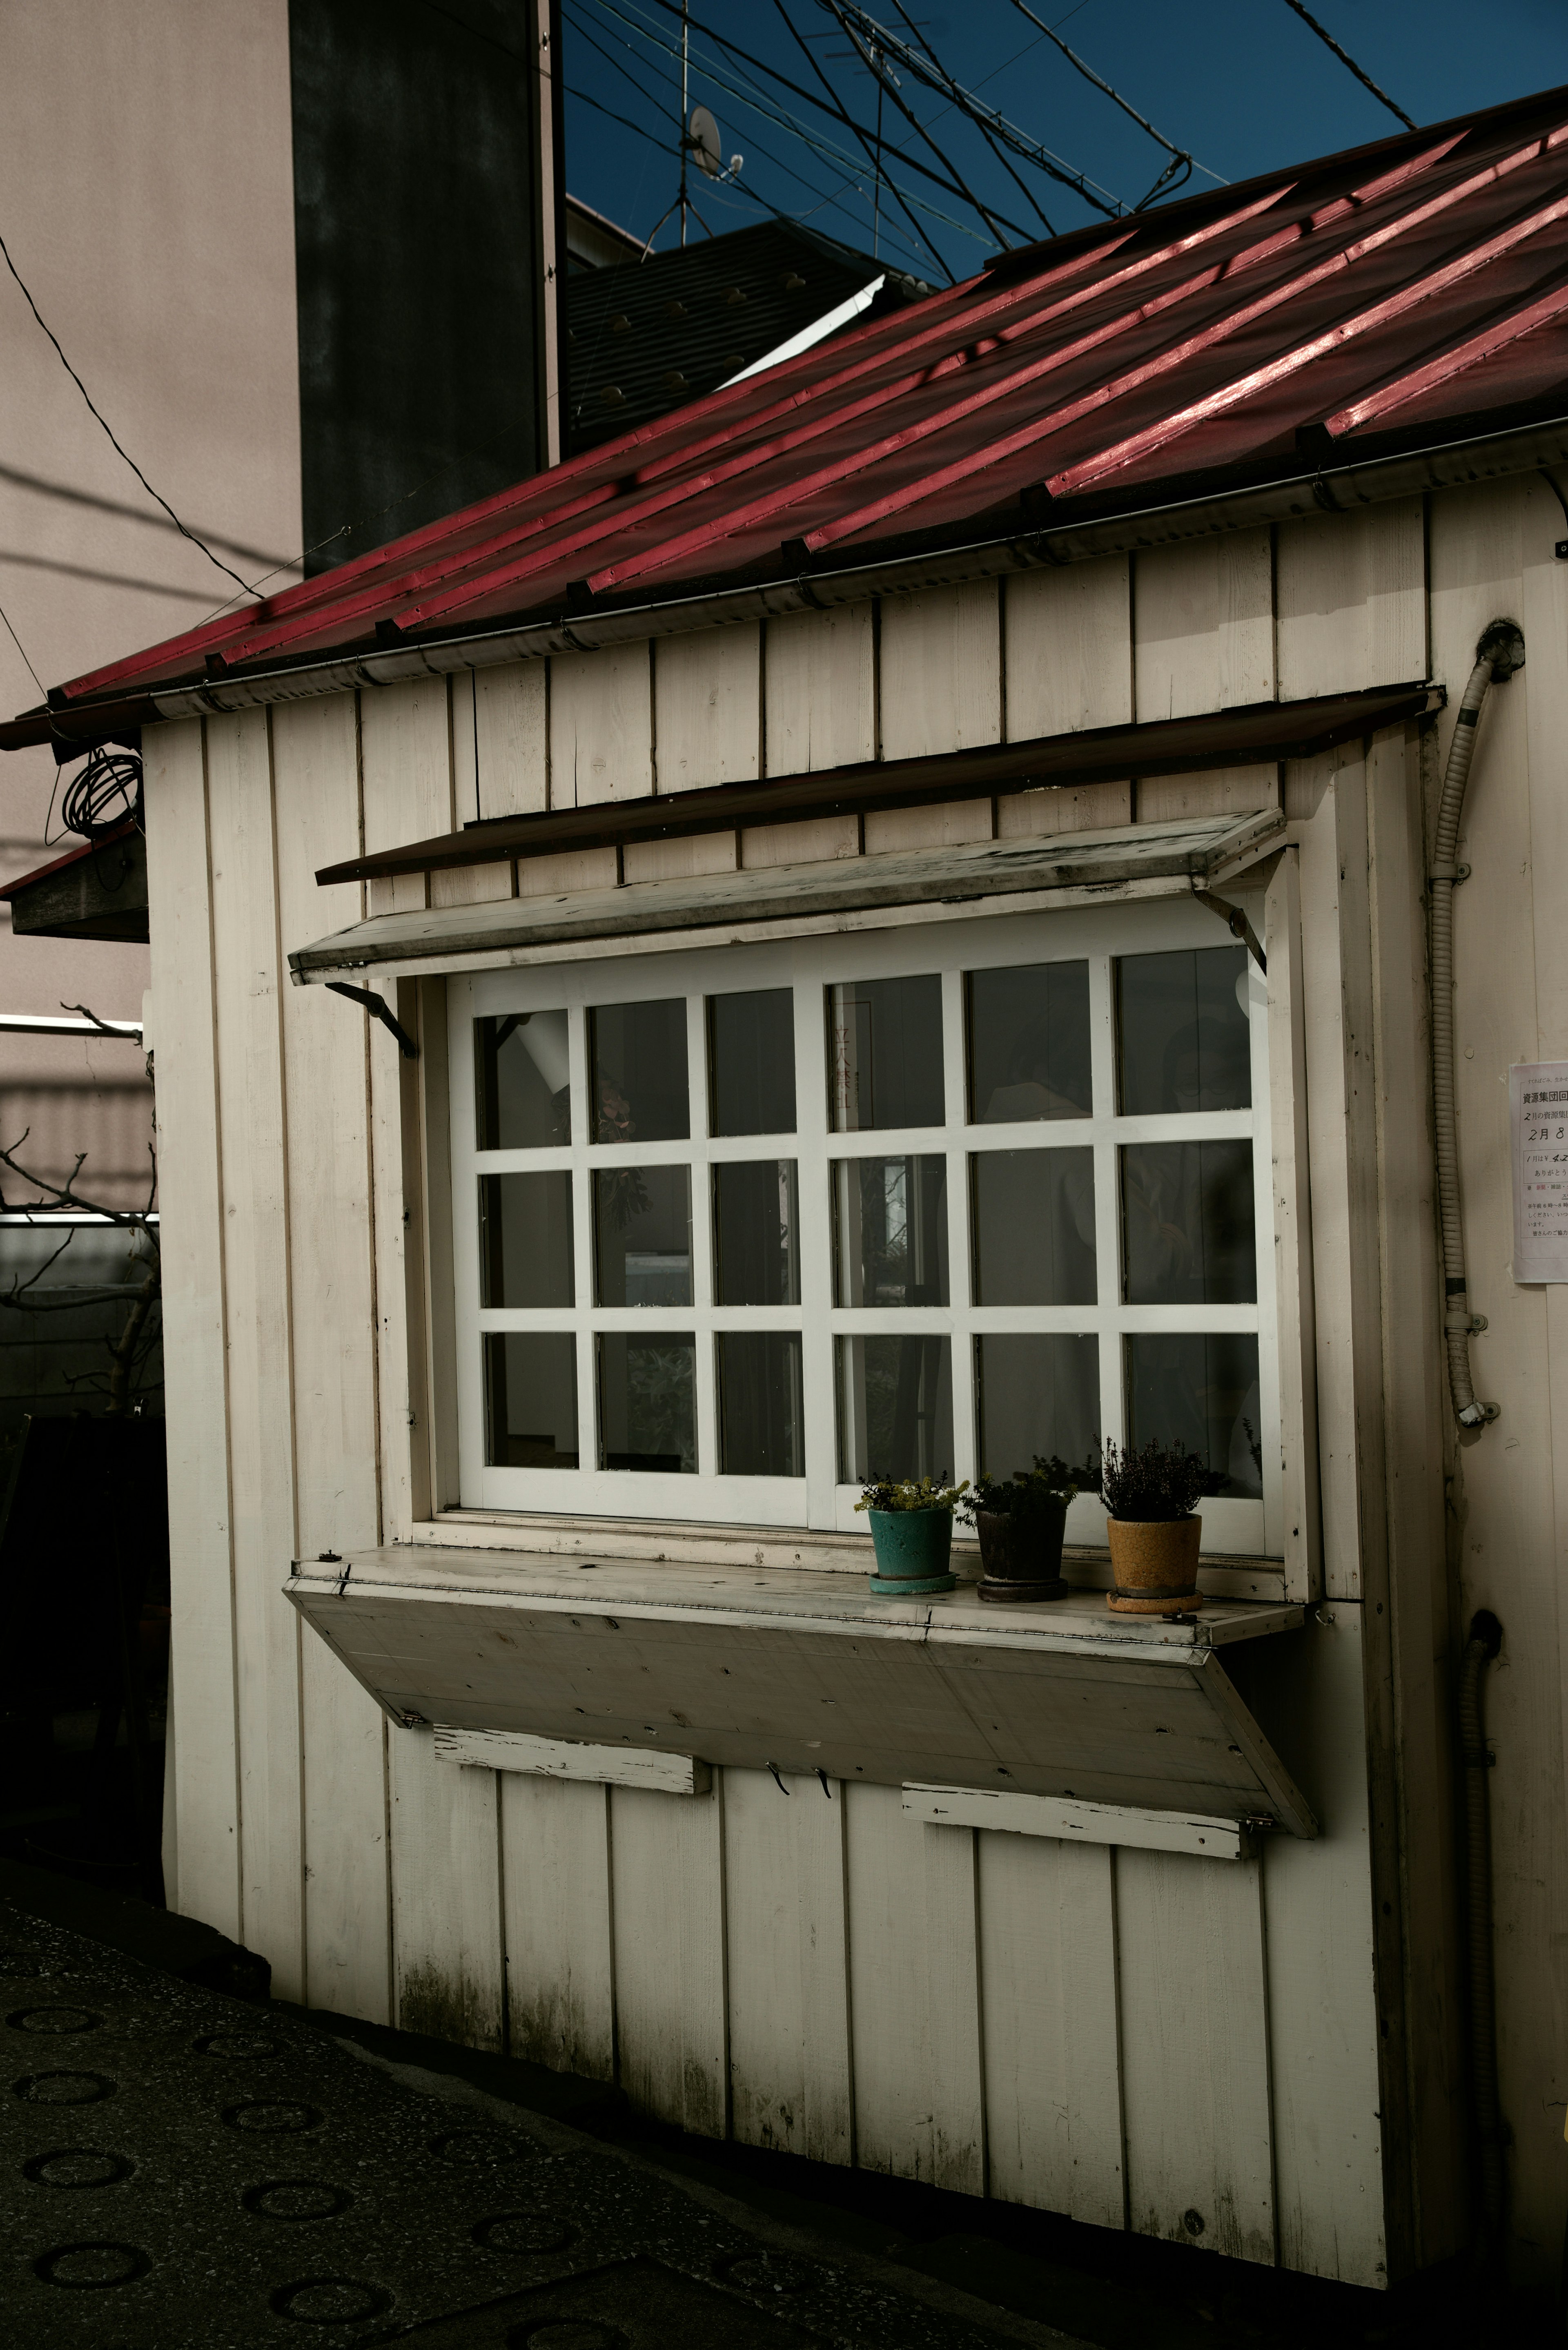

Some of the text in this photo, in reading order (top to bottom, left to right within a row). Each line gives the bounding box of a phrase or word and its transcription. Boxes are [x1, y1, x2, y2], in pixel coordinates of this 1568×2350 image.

[1523, 1091, 1568, 1104] 資源集団回
